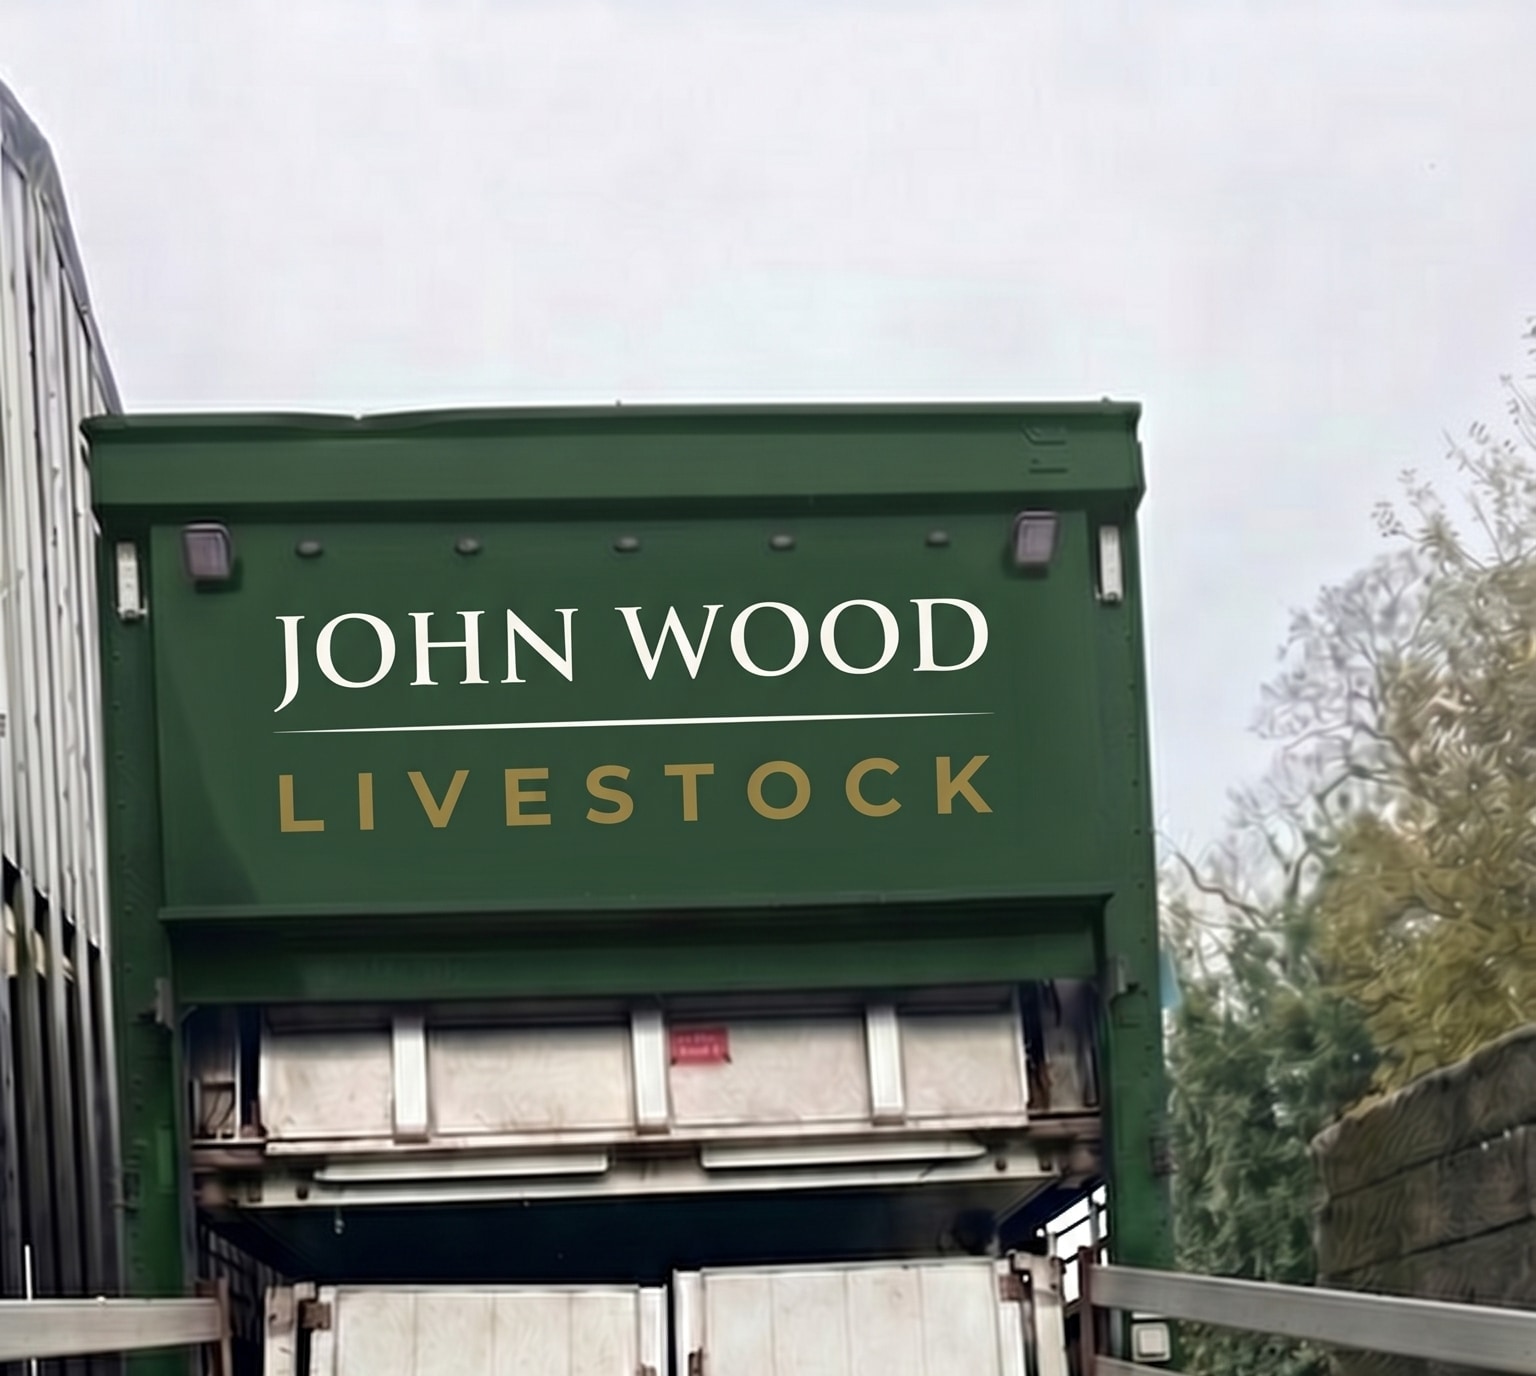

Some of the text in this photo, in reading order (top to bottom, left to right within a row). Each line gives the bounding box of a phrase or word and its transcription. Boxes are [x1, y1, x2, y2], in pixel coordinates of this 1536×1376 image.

[274, 598, 988, 712] JOHN WOOD
[279, 756, 992, 832] LIVESTOCK
